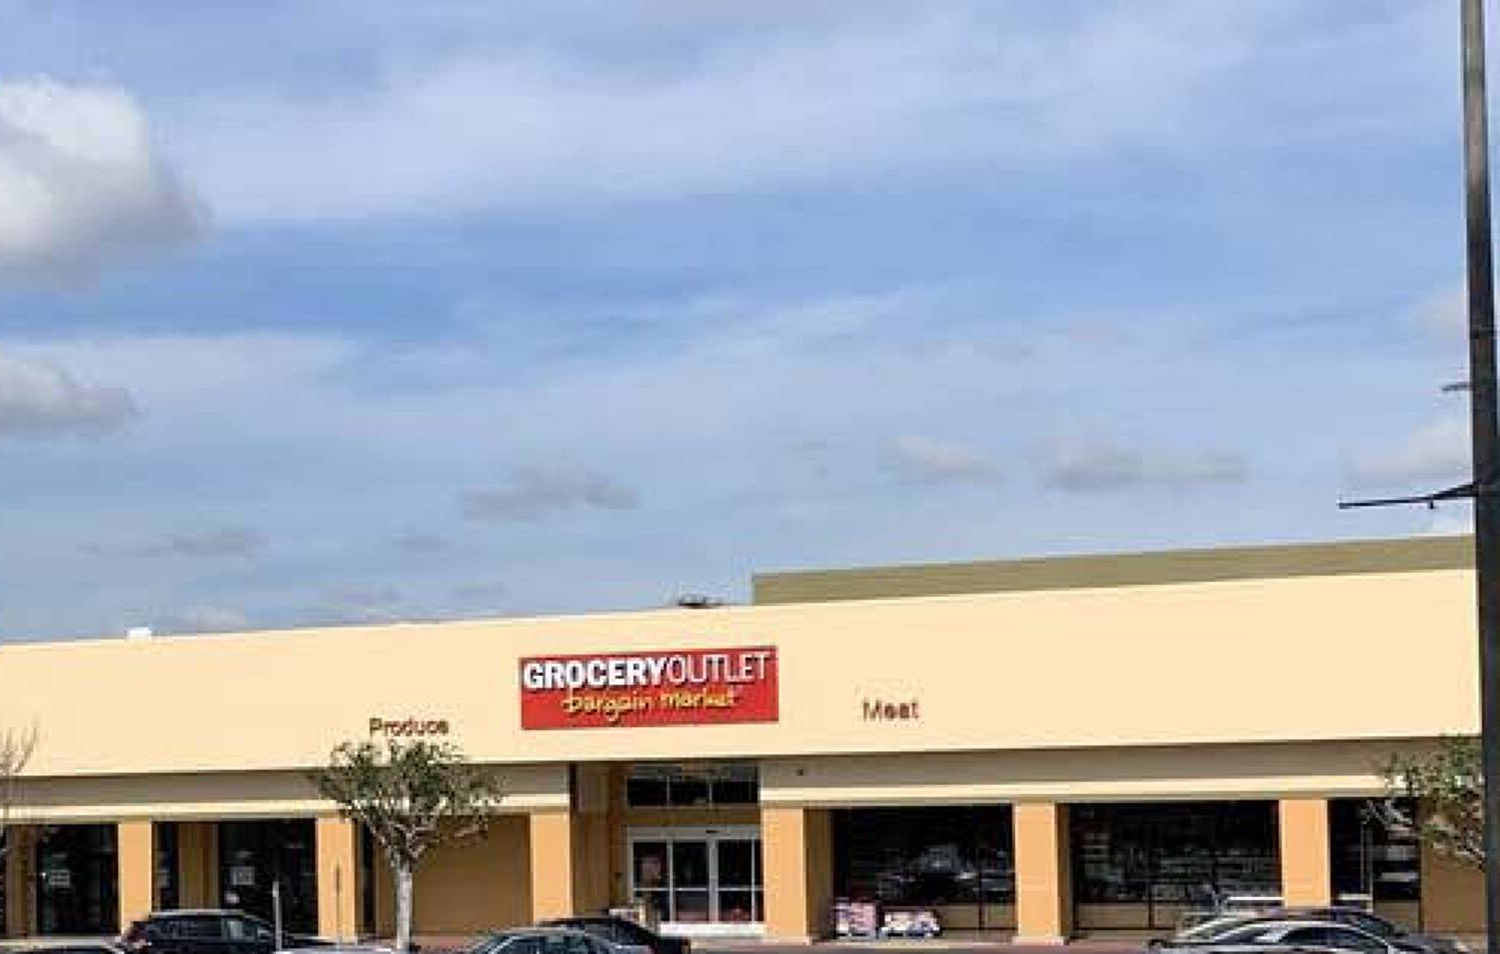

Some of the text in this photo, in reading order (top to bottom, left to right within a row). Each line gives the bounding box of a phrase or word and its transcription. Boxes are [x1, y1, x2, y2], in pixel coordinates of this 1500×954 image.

[561, 685, 736, 722] bargain market
[862, 698, 919, 721] Meat
[369, 717, 449, 737] Produce
